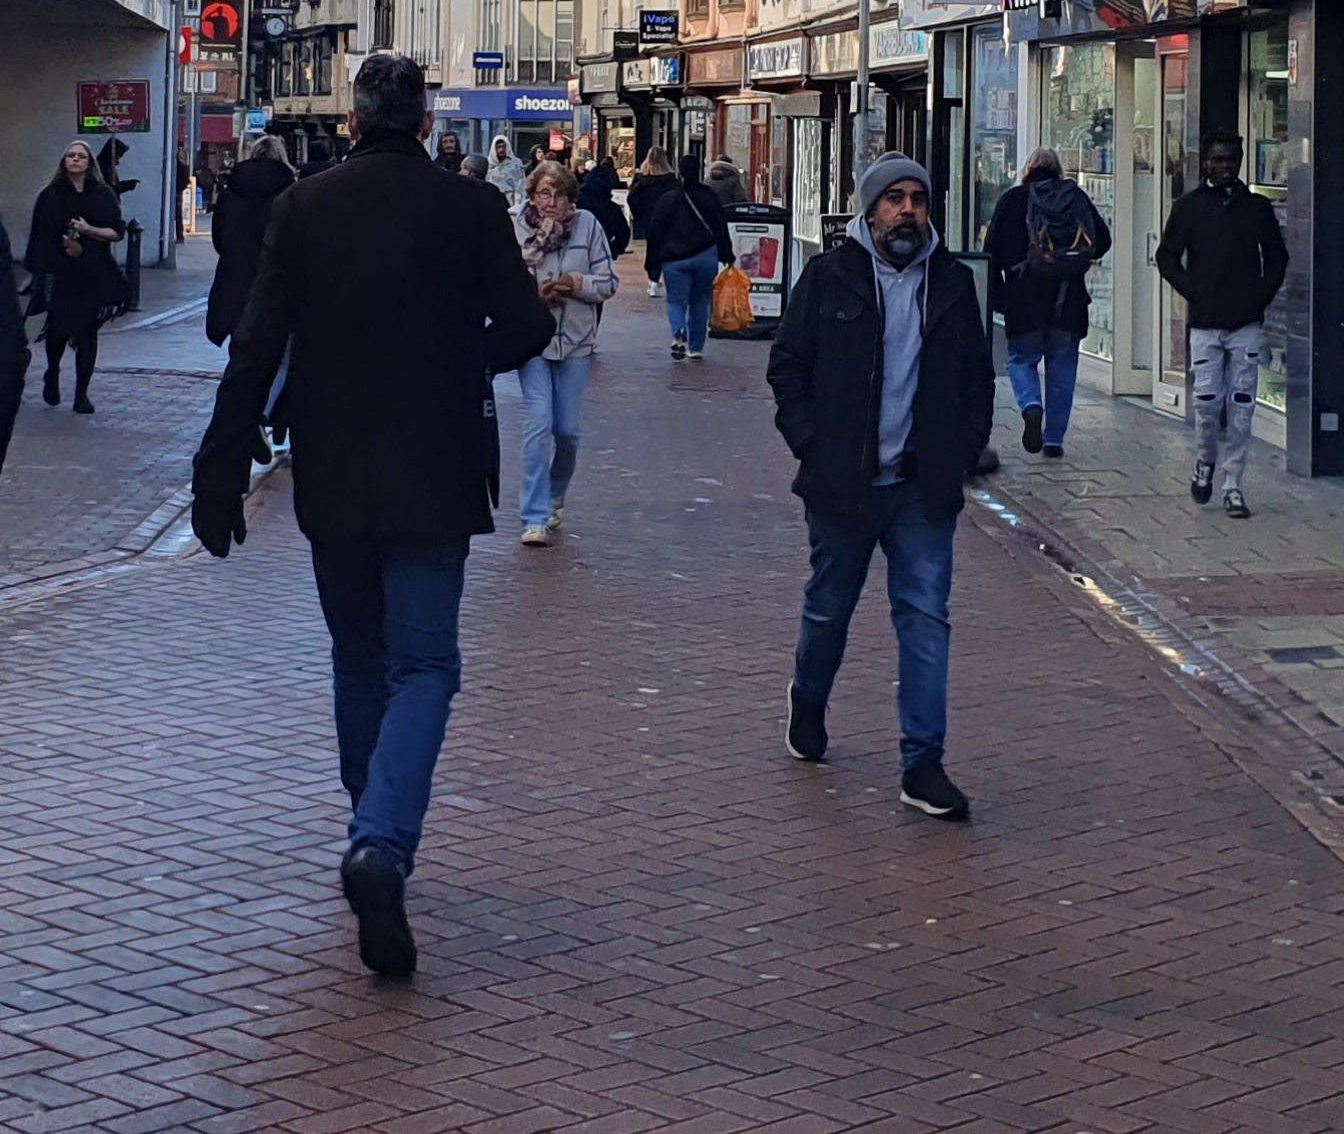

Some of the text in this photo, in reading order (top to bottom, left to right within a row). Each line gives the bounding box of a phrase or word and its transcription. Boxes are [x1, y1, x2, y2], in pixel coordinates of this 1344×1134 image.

[643, 14, 675, 25] iVape
[98, 106, 129, 115] SALE
[824, 224, 835, 235] Mr
